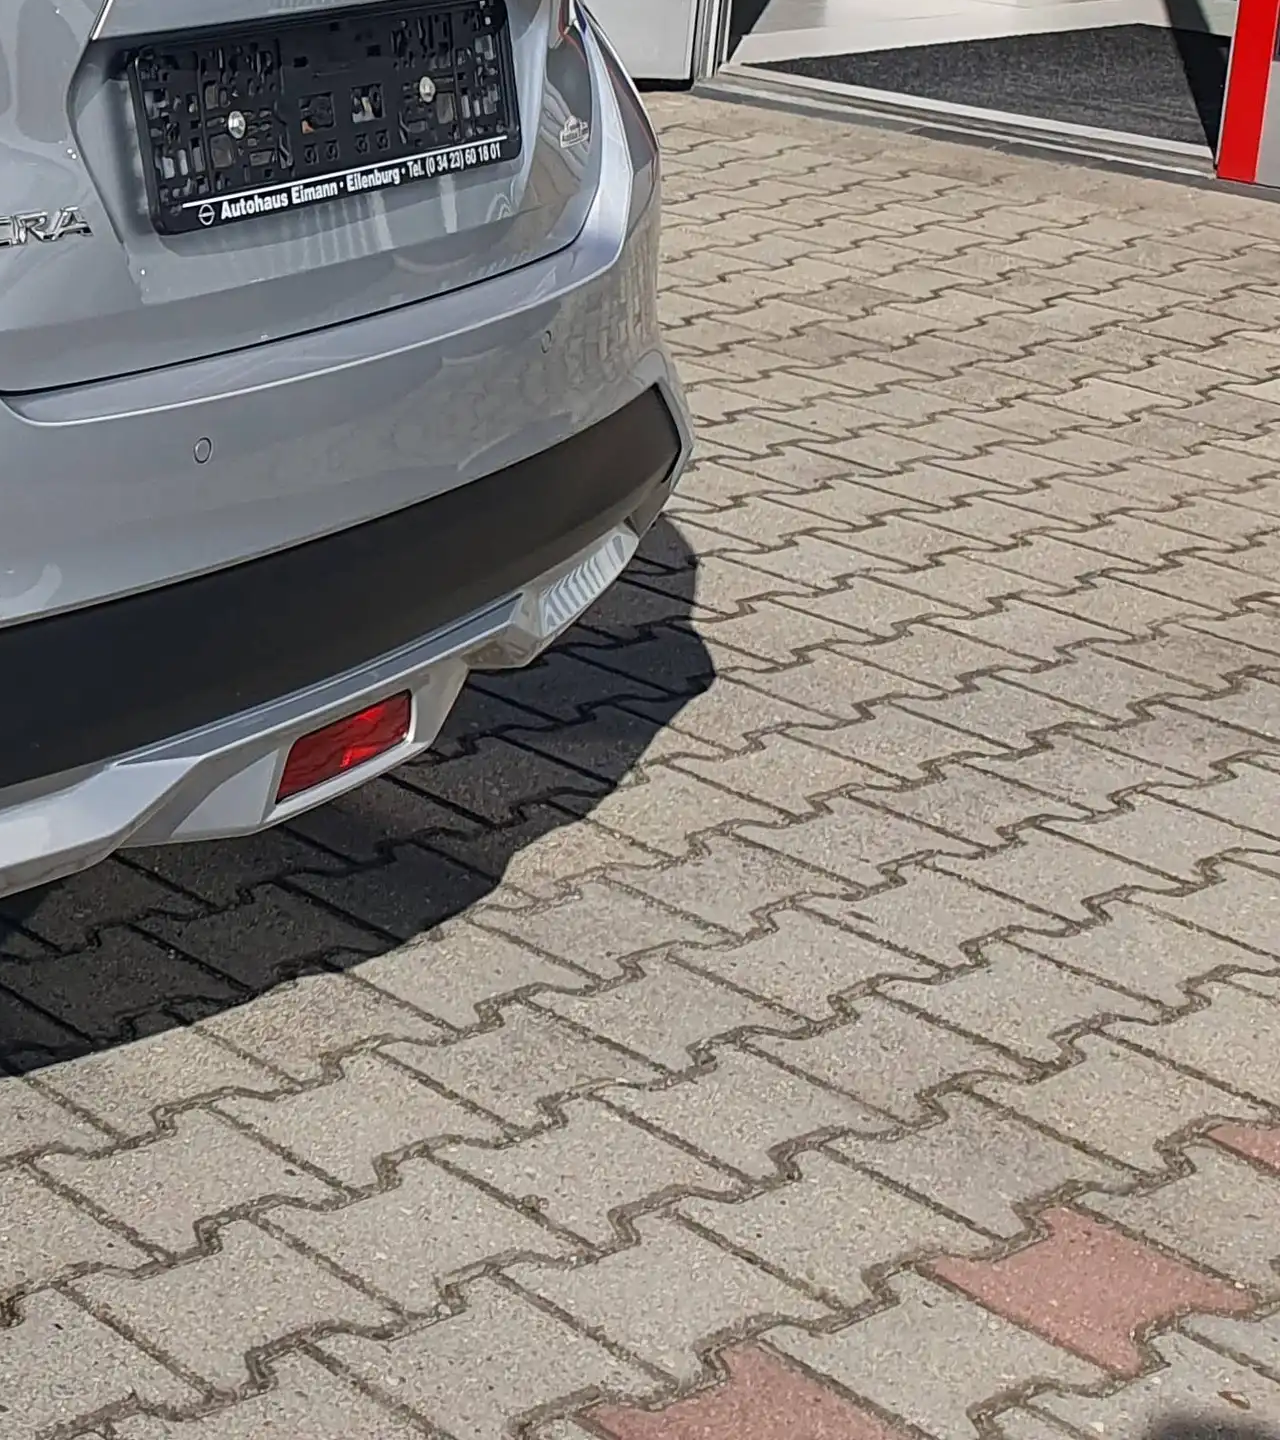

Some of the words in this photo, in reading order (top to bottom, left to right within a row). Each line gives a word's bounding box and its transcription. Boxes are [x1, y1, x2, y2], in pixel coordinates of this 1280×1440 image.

[220, 191, 289, 221] Autohaus
[291, 183, 338, 205] Eimann
[346, 168, 400, 192] Eilenburg
[407, 160, 424, 178] Tel.
[425, 156, 435, 178] (0
[436, 154, 448, 173] 34
[449, 149, 464, 170] 23)
[465, 148, 477, 165] 60
[478, 144, 489, 162] 18
[489, 142, 501, 160] 01
